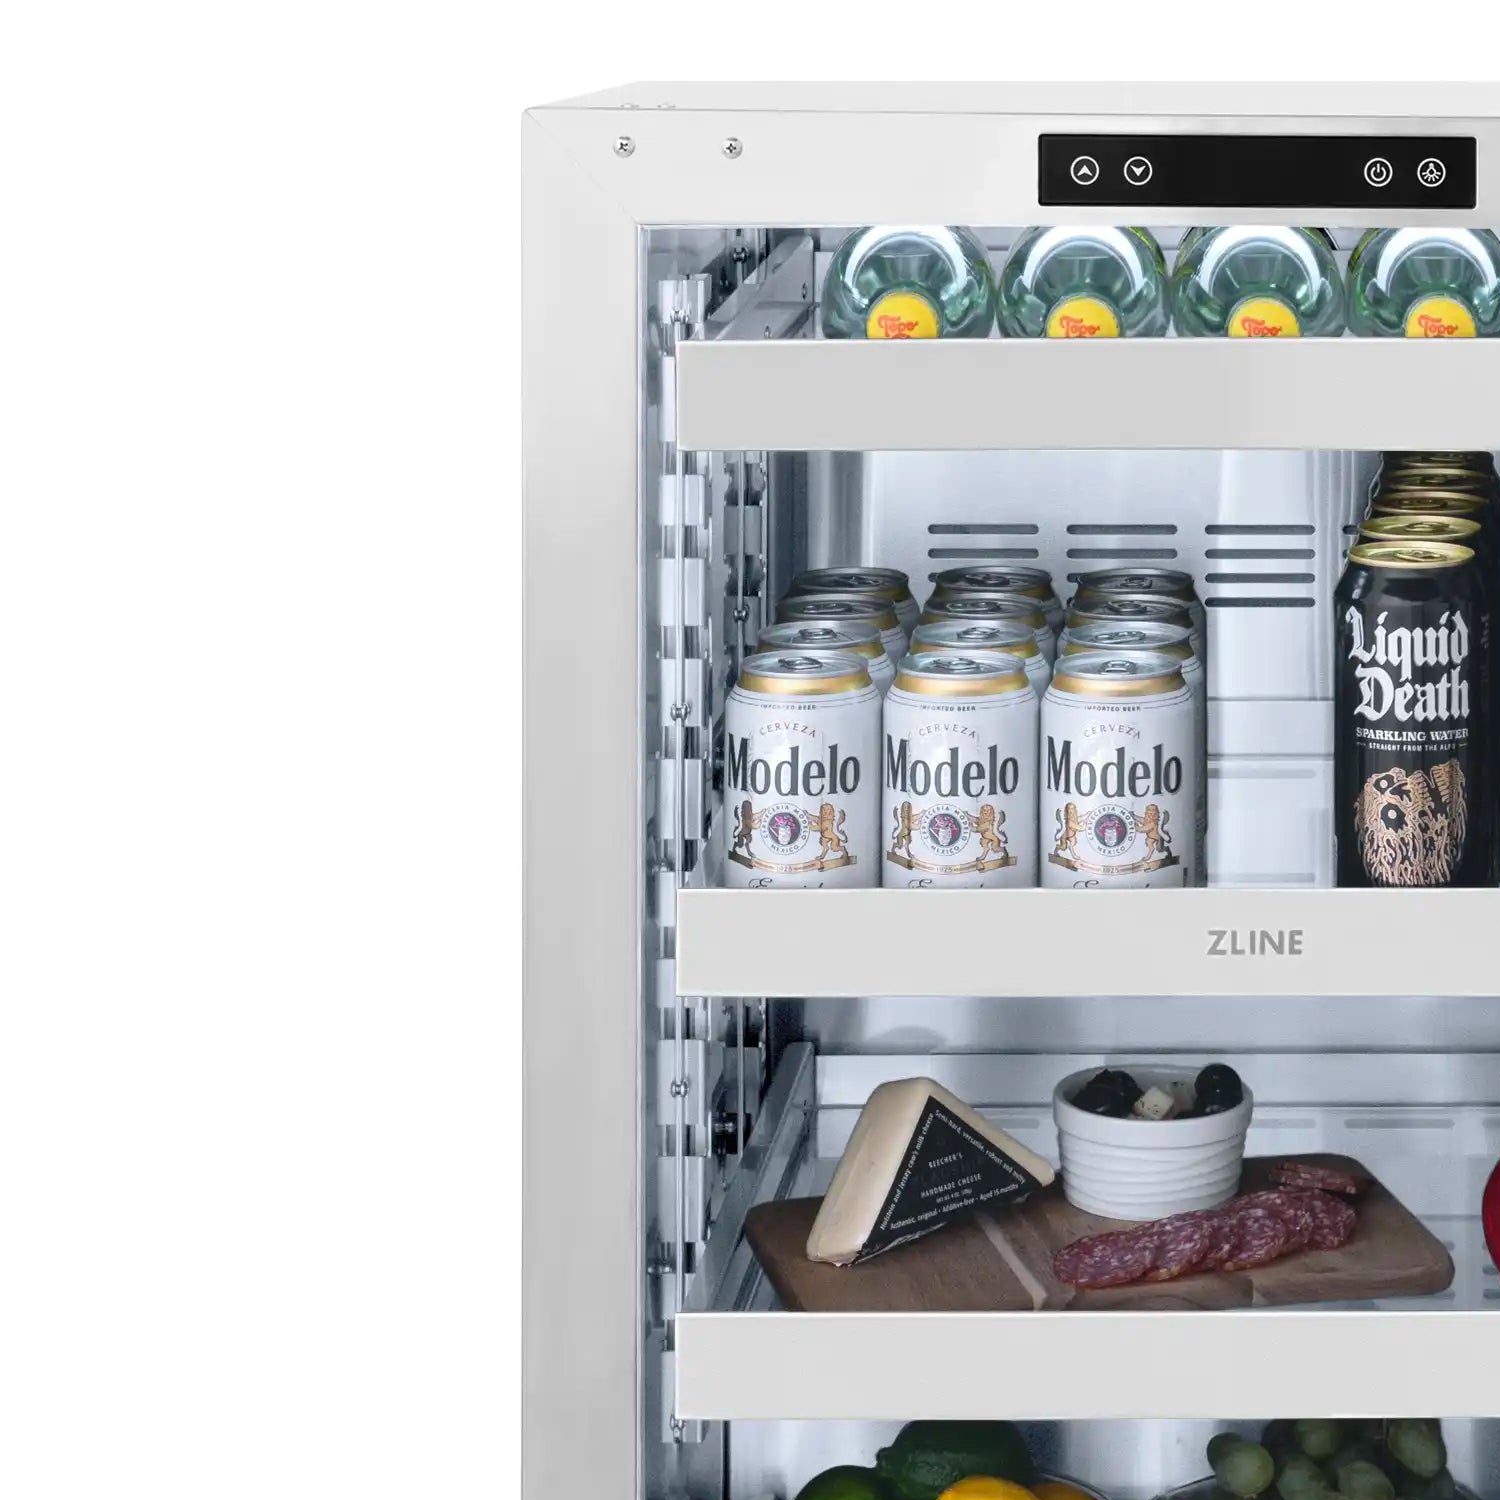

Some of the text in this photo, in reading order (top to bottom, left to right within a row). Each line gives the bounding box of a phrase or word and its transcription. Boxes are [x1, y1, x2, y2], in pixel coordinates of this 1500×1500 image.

[877, 314, 919, 334] Topo
[1059, 315, 1101, 337] Topo
[1241, 315, 1282, 338] Topo
[1417, 314, 1459, 337] Topo
[1345, 605, 1469, 682] Liquid
[1354, 664, 1470, 722] Death
[760, 721, 816, 738] CERVEZA
[918, 723, 976, 739] CERVEZA
[1083, 723, 1141, 740] CERVEZA
[1356, 726, 1469, 742] SPARKLING WATER
[1369, 742, 1400, 751] STRAIGHT
[1403, 744, 1422, 752] FROM
[1425, 744, 1438, 752] THE
[728, 732, 860, 797] Modelo
[886, 732, 1019, 798] Modelo
[1047, 735, 1182, 798] Modelo
[1206, 929, 1304, 955] ZLINE
[880, 1203, 896, 1231] Holstein
[893, 1189, 902, 1203] and
[899, 1168, 912, 1191] Jersey
[922, 1112, 934, 1135] cheese
[920, 1181, 955, 1198] HANDMADE
[957, 1173, 981, 1187] CHEESE
[917, 1208, 938, 1222] original
